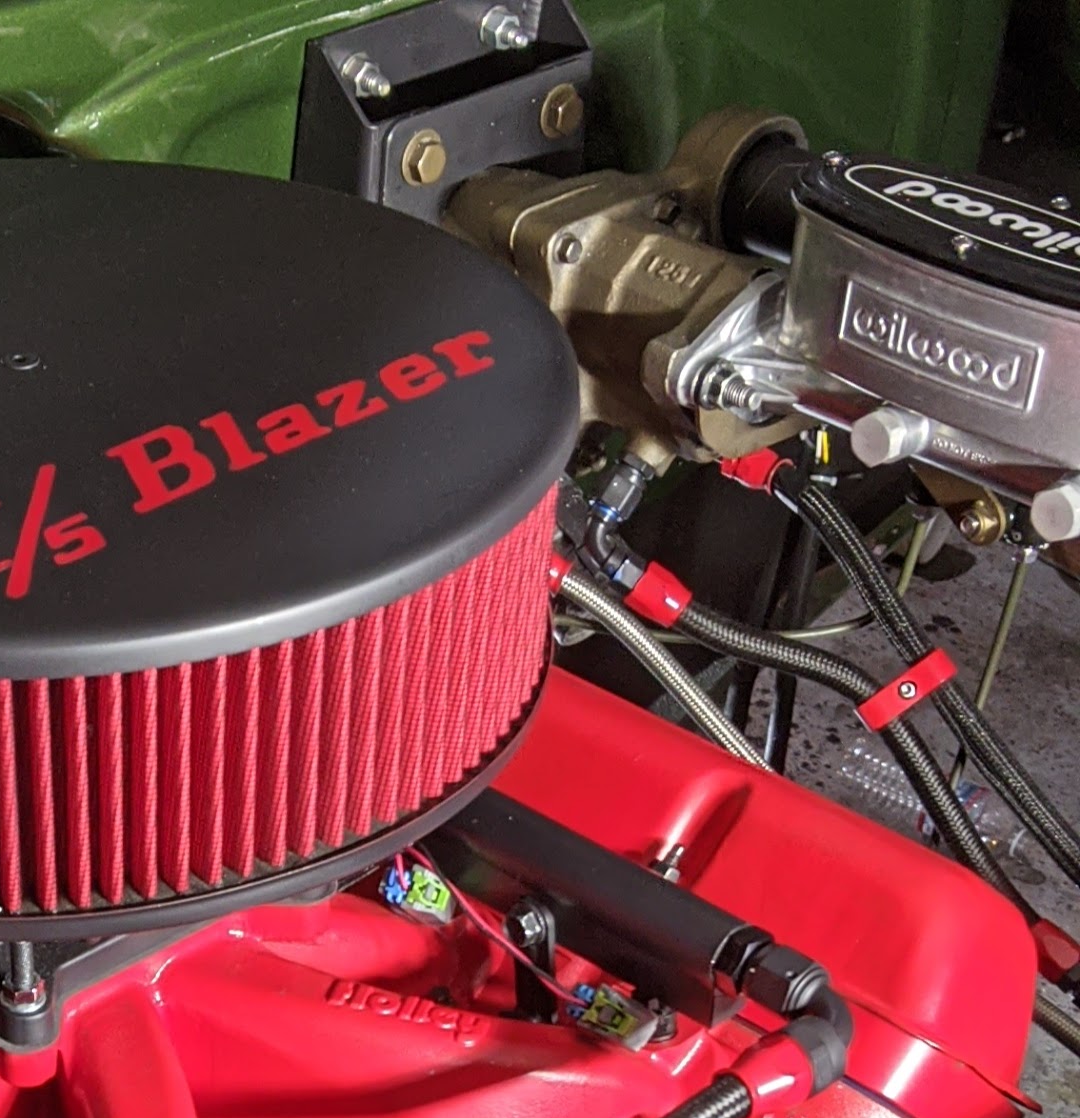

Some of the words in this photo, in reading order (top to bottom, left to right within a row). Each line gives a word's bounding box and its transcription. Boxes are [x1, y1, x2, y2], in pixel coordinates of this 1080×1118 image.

[883, 179, 1080, 257] ilwood
[853, 306, 1020, 392] wilwood
[107, 332, 493, 514] Blazer
